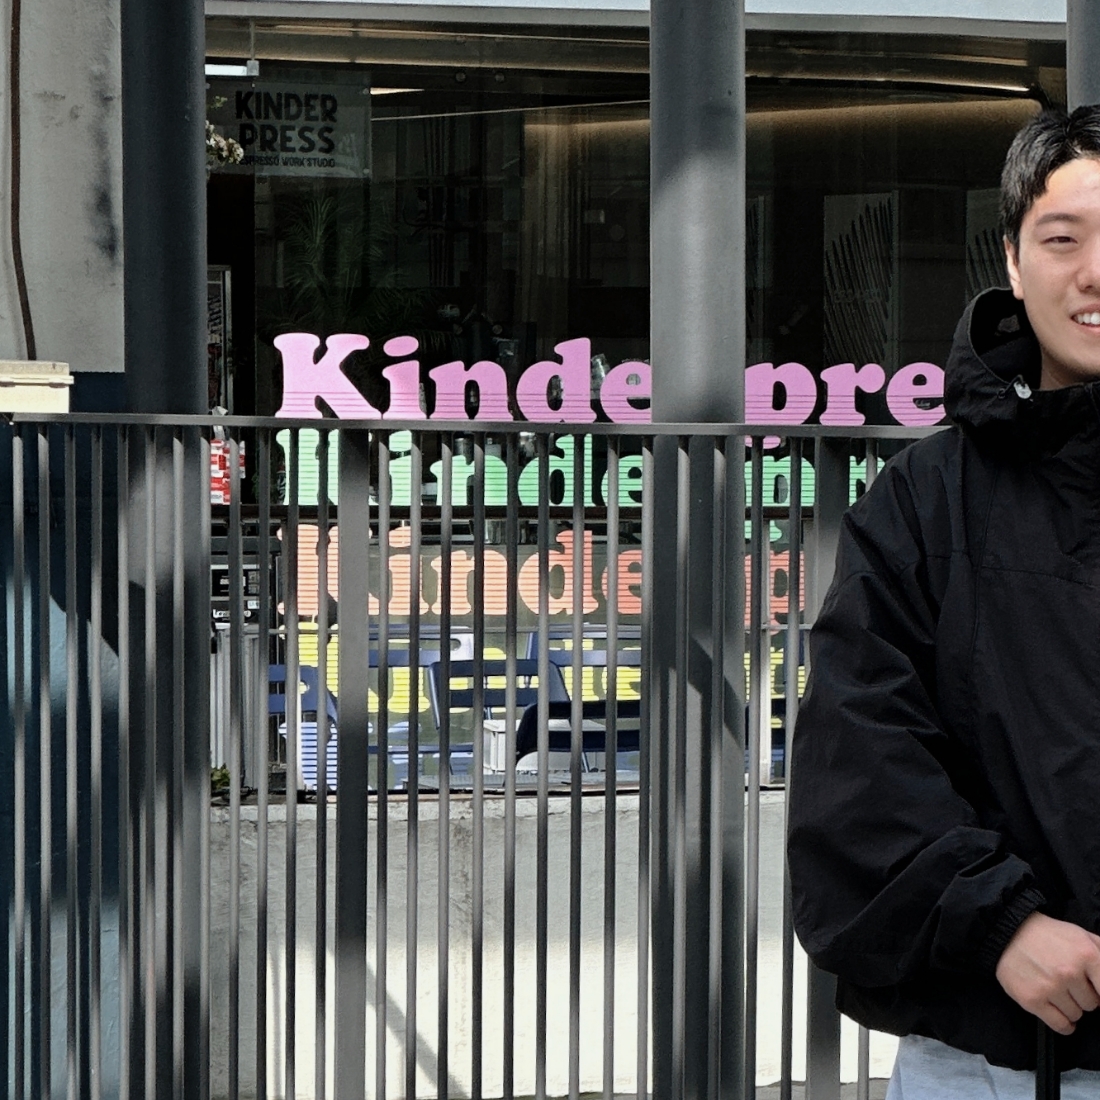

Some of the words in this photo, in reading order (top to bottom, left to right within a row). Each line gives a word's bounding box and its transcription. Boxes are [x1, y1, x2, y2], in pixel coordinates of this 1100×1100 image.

[235, 91, 338, 122] KINDER
[238, 123, 336, 154] PRESS
[307, 157, 335, 168] STUDIO
